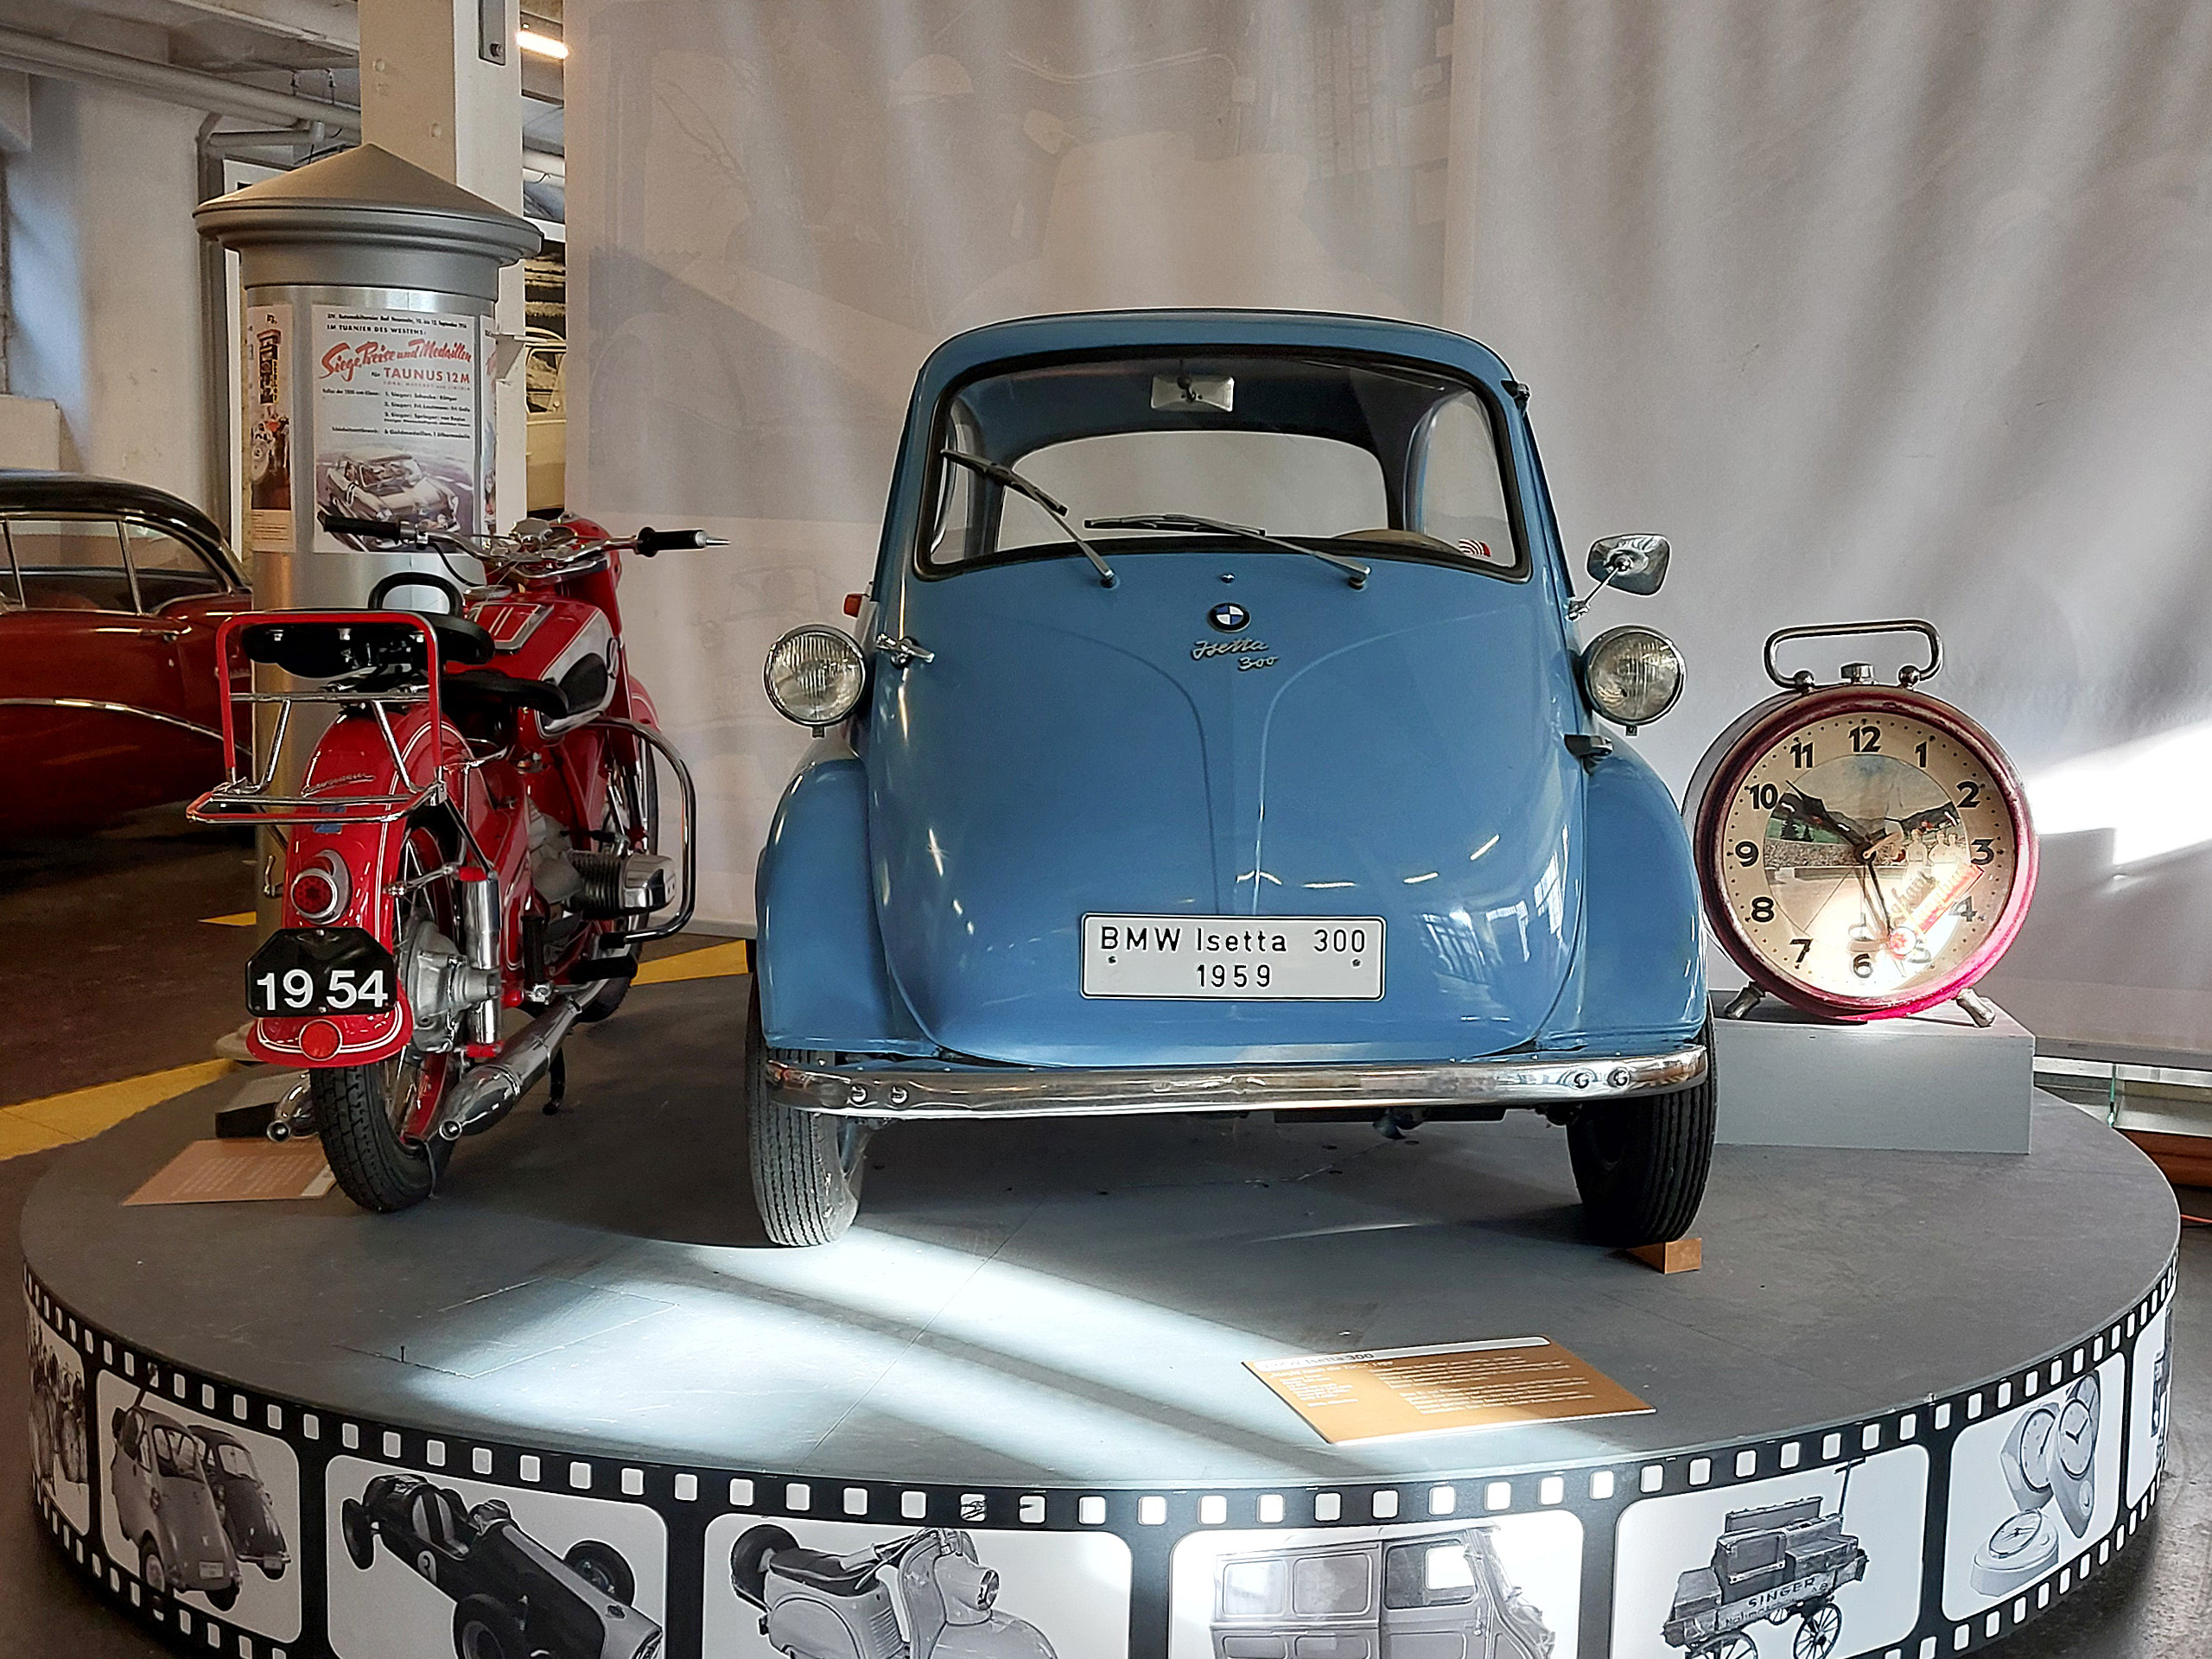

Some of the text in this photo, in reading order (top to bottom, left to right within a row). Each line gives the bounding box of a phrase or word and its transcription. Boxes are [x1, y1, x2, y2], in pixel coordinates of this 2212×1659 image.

[408, 339, 472, 363] Medaillen
[384, 367, 442, 381] TAUNUS
[446, 372, 470, 384] 12M
[1849, 726, 1881, 753] 12
[1790, 742, 1813, 768] 11
[1915, 741, 1927, 768] 1
[1751, 784, 1777, 809] 10
[1956, 782, 1981, 808] 2
[1735, 841, 1759, 867] 9
[1971, 838, 1994, 865] 3
[1751, 897, 1774, 922] 8
[1948, 895, 1977, 922] 4
[1102, 926, 1366, 952] BMW Isetta 300
[1789, 938, 1813, 963] 7
[1196, 964, 1271, 988] 1959
[1853, 954, 1873, 979] 6
[257, 969, 388, 1011] 19 54
[1748, 1578, 1815, 1607] SINGER
